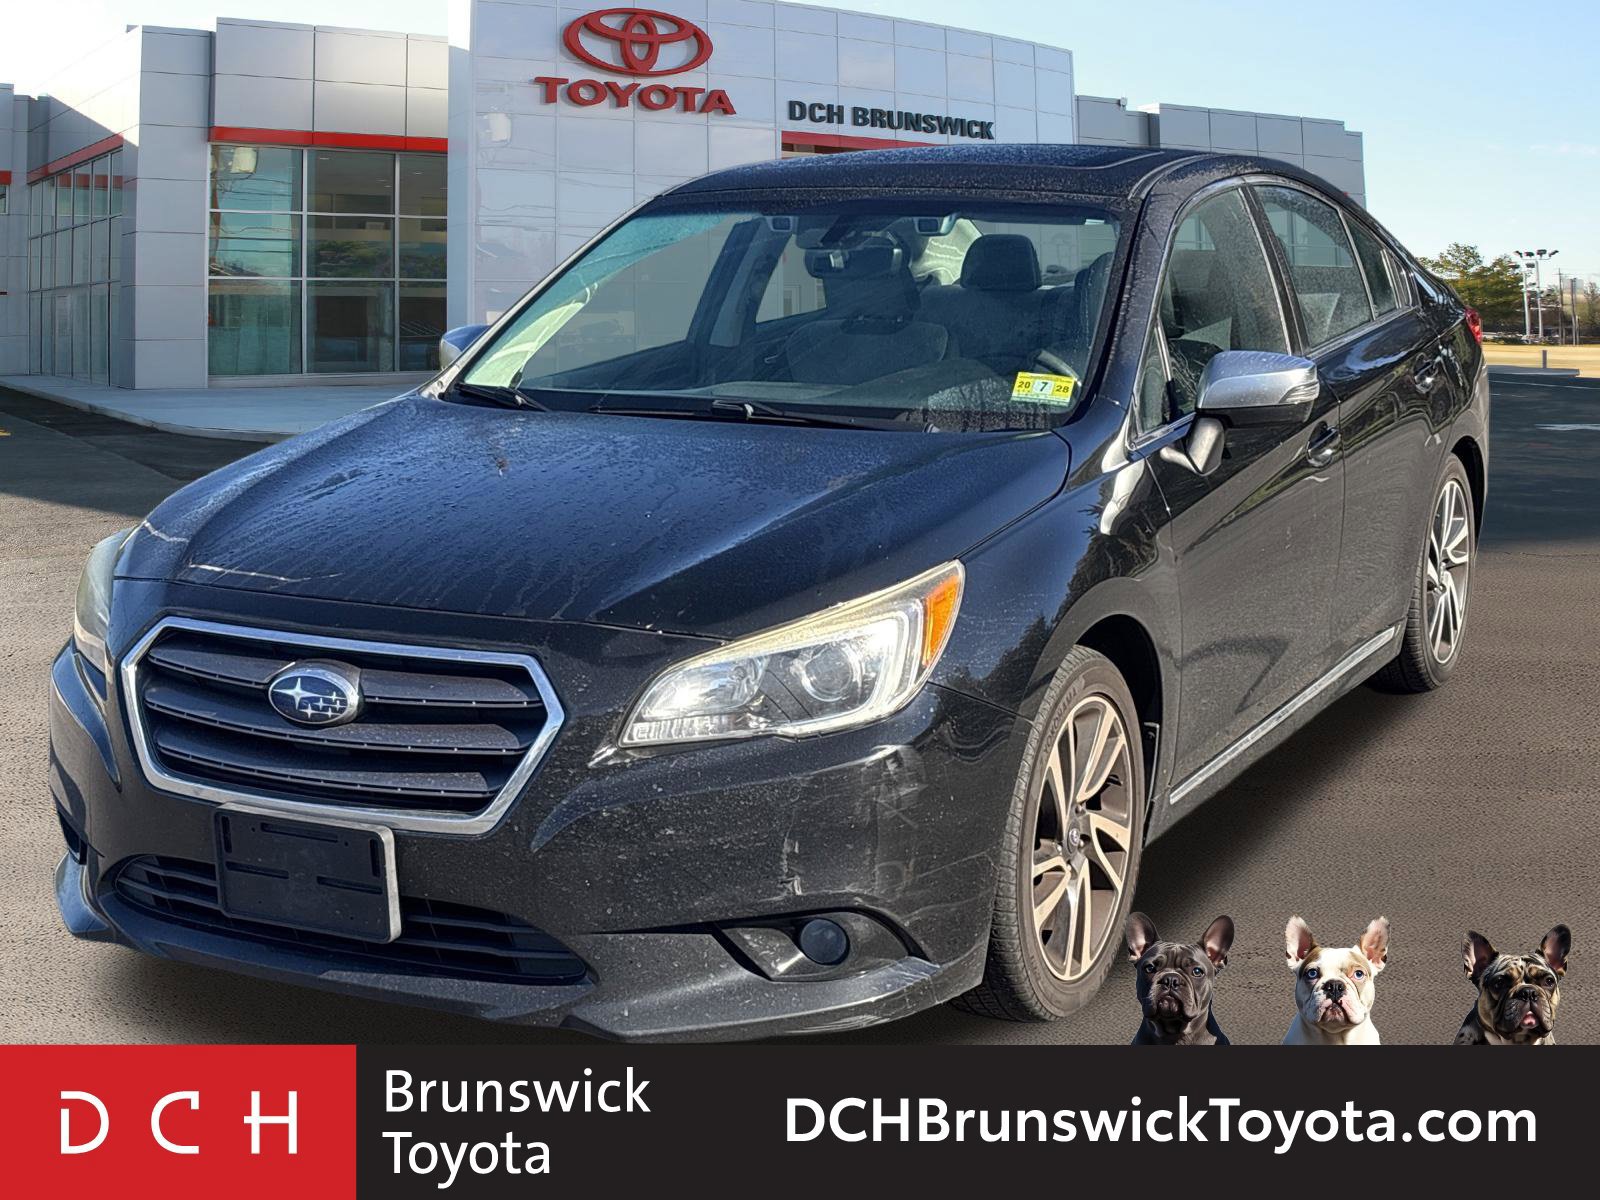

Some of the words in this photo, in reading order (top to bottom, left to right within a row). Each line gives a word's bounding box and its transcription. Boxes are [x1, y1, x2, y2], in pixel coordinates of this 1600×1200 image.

[534, 76, 736, 115] TOYOTA
[788, 100, 845, 125] DCH
[851, 106, 995, 140] BRUNSWICK
[1017, 380, 1032, 389] 20
[1039, 381, 1049, 392] 7
[1055, 385, 1070, 394] 28
